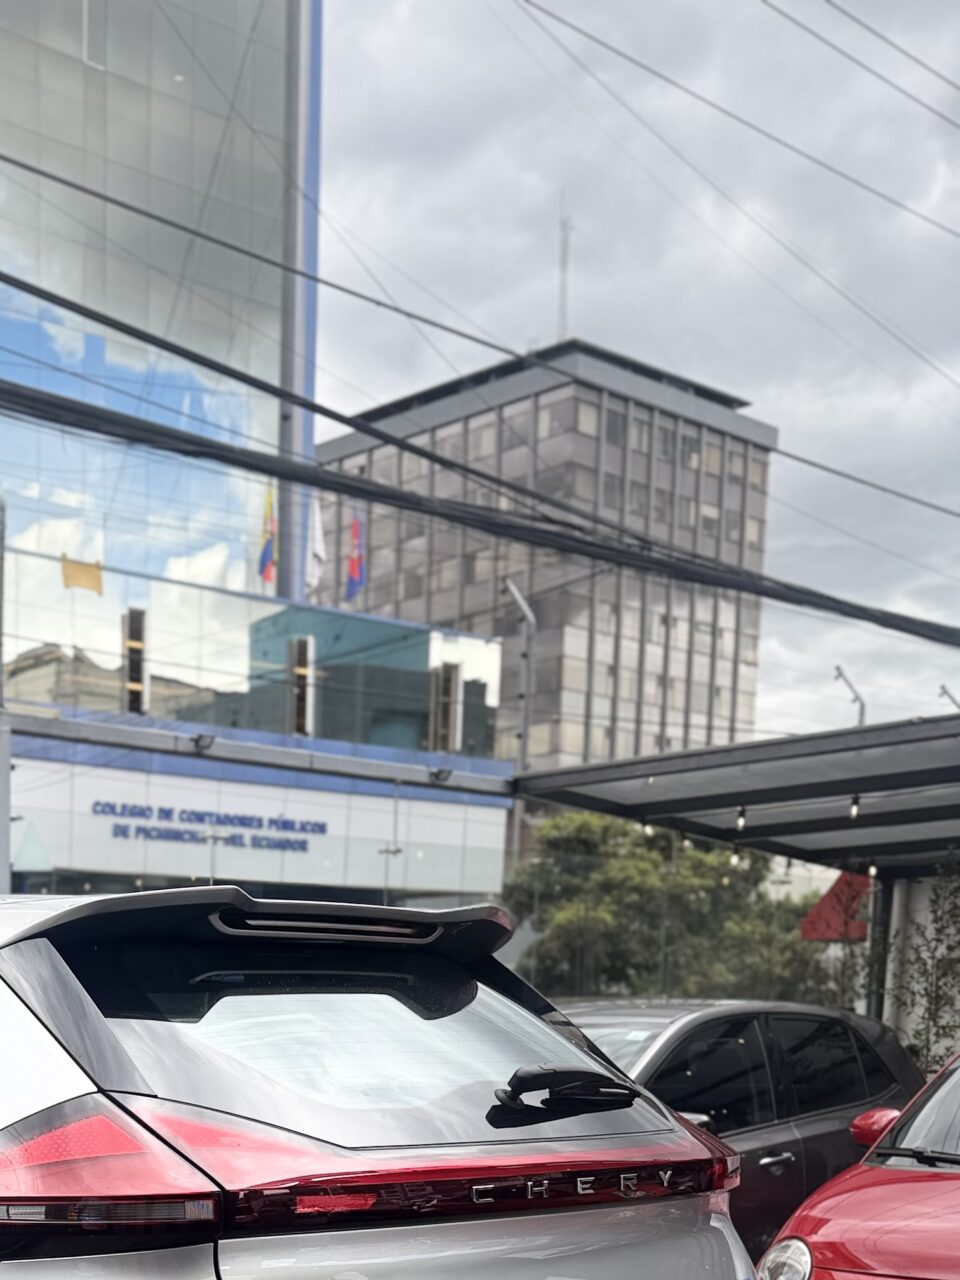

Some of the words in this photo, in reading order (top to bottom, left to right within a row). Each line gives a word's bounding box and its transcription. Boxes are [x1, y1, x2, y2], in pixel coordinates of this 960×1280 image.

[92, 801, 153, 819] COLEGIO
[158, 807, 174, 822] DE
[178, 809, 263, 829] CONTADORES
[112, 823, 130, 839] DE
[251, 835, 308, 852] ECUADOR
[472, 1170, 673, 1203] CHERY
